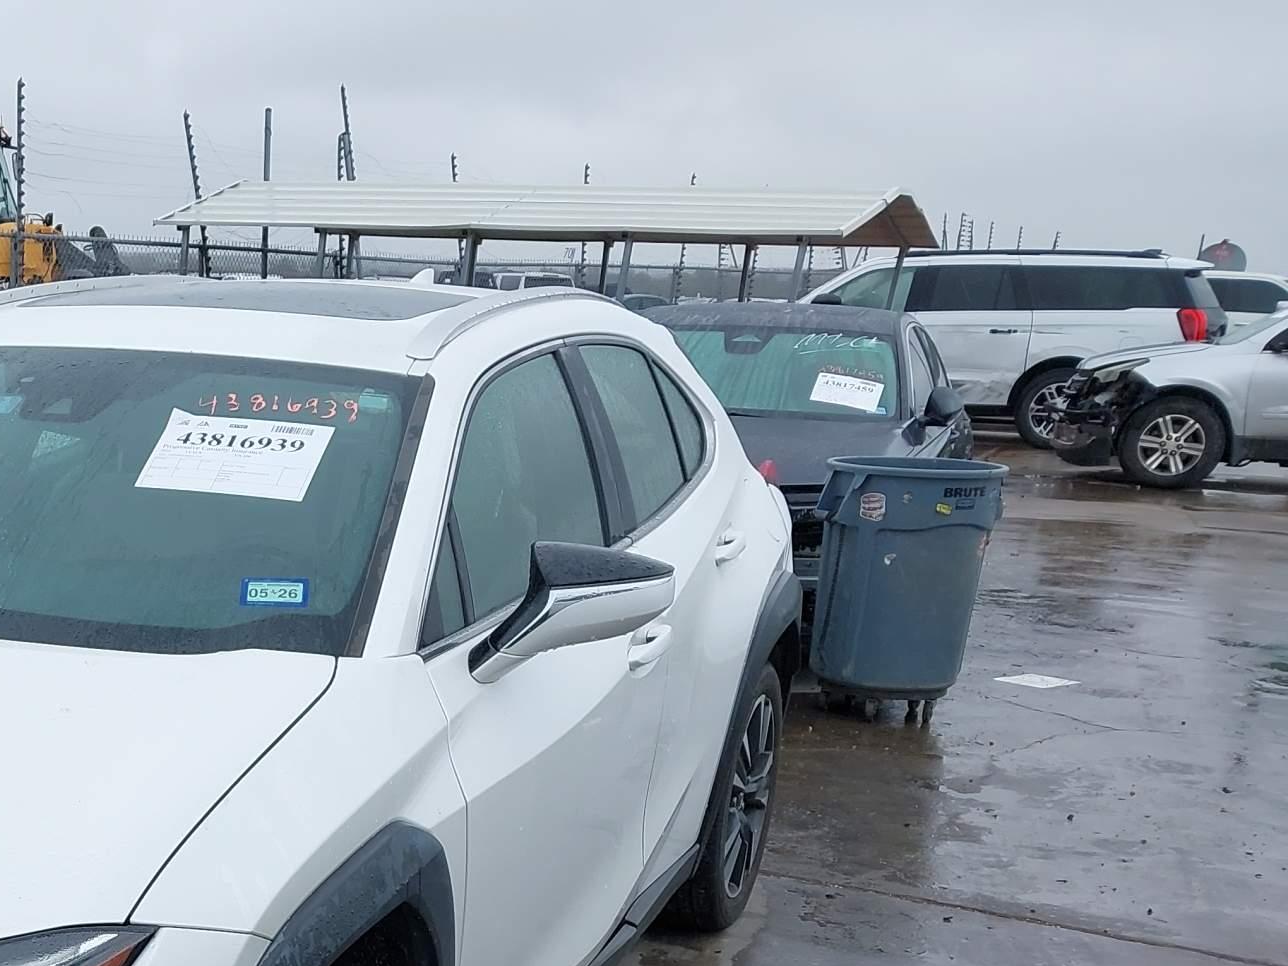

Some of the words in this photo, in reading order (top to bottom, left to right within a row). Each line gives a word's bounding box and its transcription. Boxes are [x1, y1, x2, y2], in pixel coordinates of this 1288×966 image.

[199, 392, 360, 424] 43816939
[176, 431, 305, 453] 43816939
[943, 486, 987, 498] BRUTE
